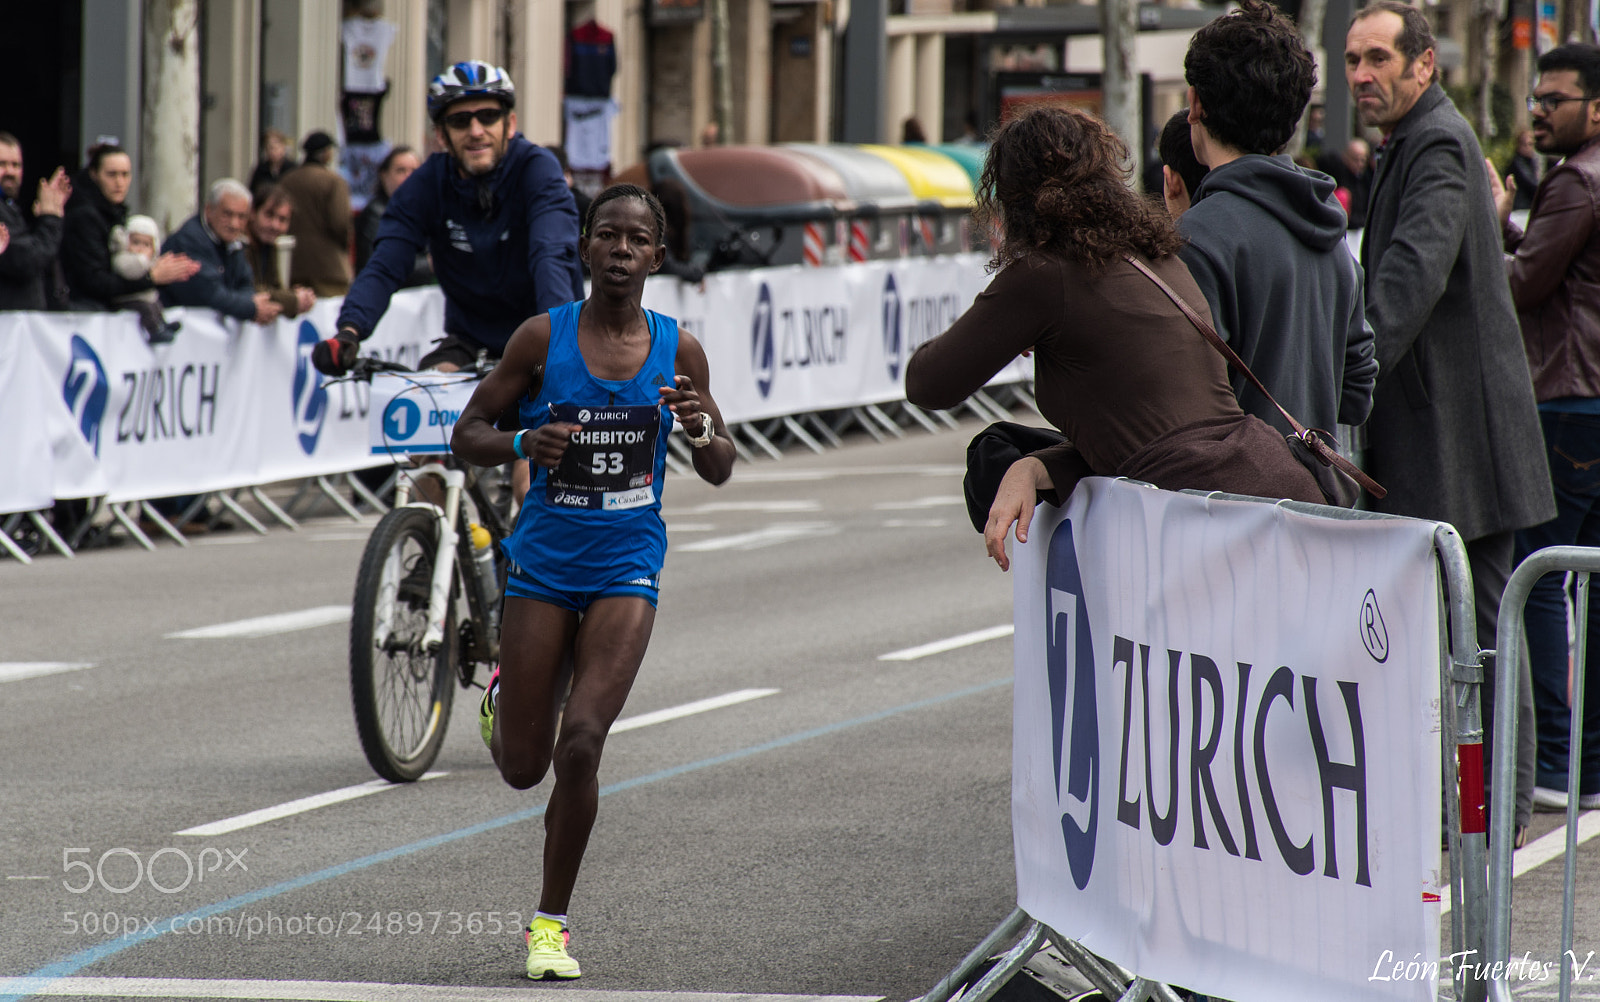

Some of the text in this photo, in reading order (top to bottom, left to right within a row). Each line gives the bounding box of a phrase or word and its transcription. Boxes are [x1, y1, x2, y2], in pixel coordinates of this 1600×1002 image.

[780, 306, 848, 368] ZURICH
[117, 363, 220, 443] ZURICH
[594, 411, 629, 421] ZURICH
[570, 430, 646, 445] CHEBITOK
[591, 452, 625, 475] 53
[1112, 634, 1373, 888] ZURICH
